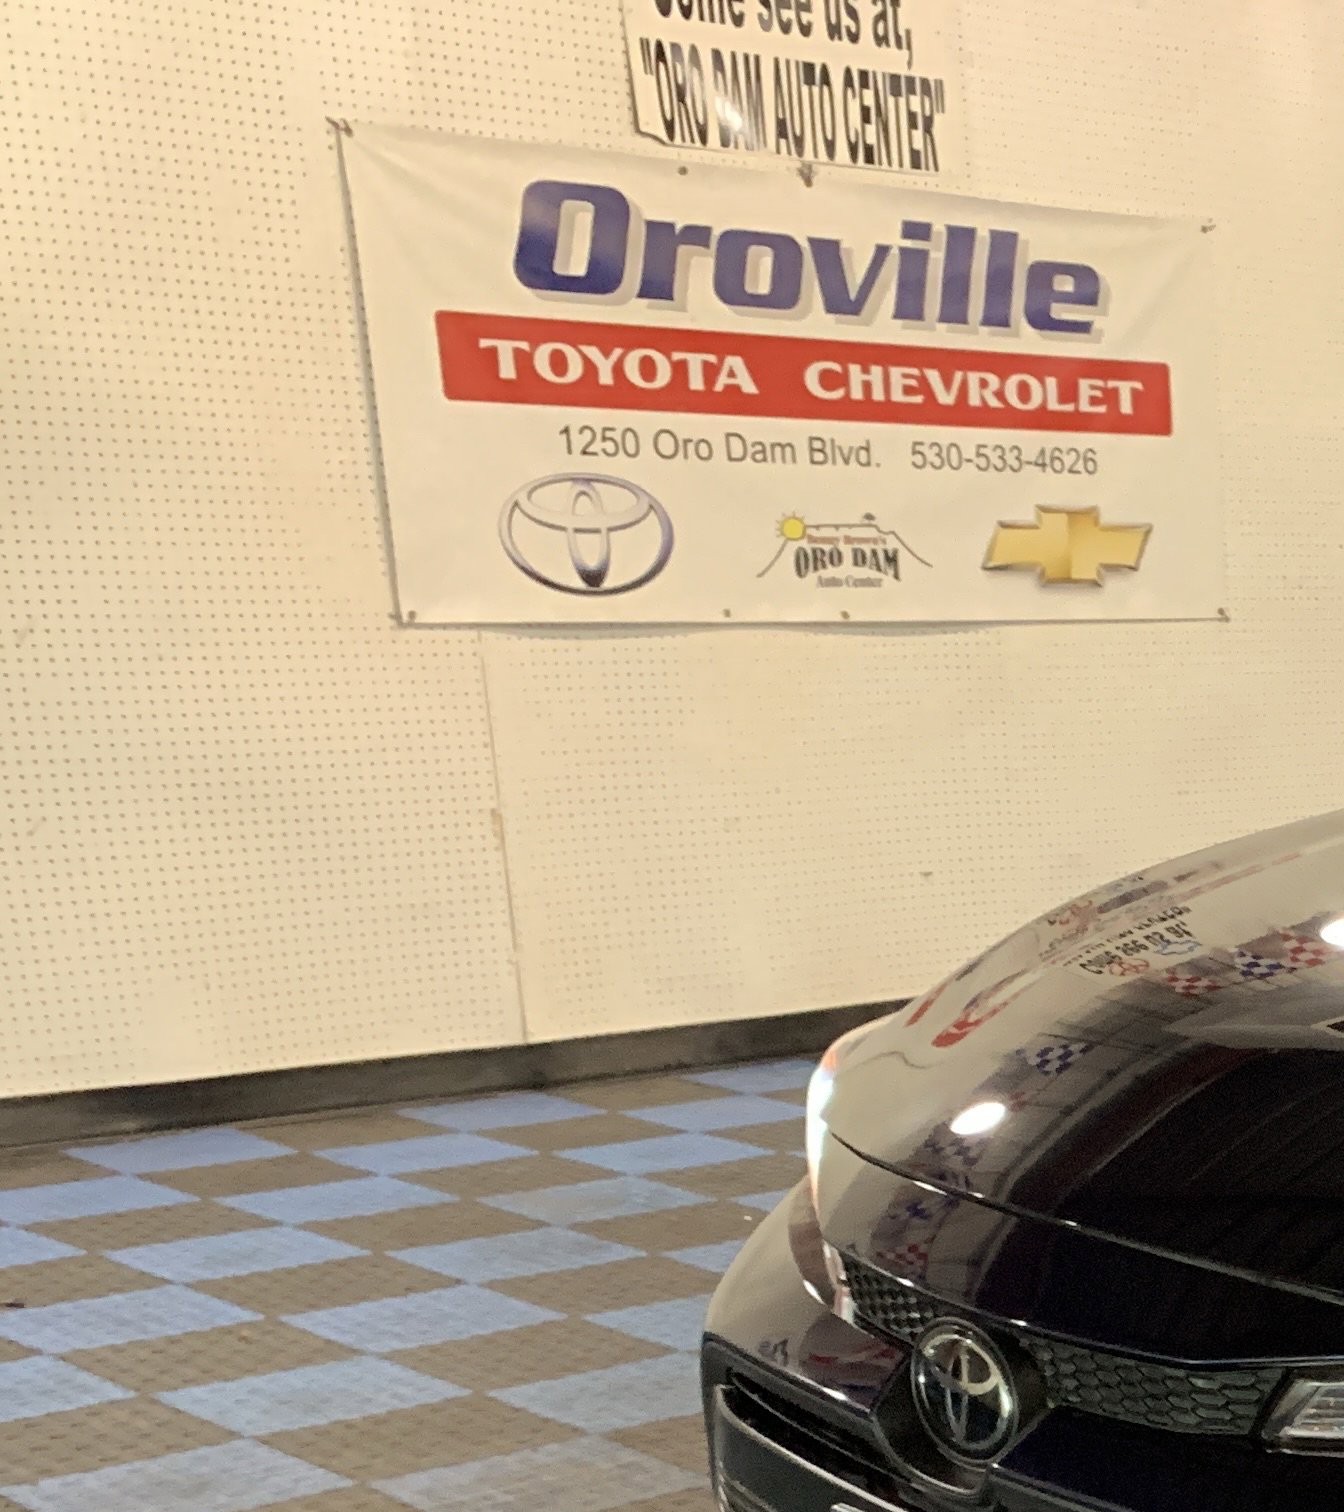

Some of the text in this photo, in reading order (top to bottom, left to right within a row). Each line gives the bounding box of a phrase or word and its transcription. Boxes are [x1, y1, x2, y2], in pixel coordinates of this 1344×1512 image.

[825, 0, 861, 45] us
[639, 37, 945, 172] "ORO DAM AUTO CENTER"
[513, 180, 1101, 335] Oroville
[478, 338, 1144, 415] TOYOTA CHEVROLET
[558, 424, 1099, 476] 1250 Oro Dam Blvd. 530-533-4626
[794, 546, 902, 582] ORO DAM
